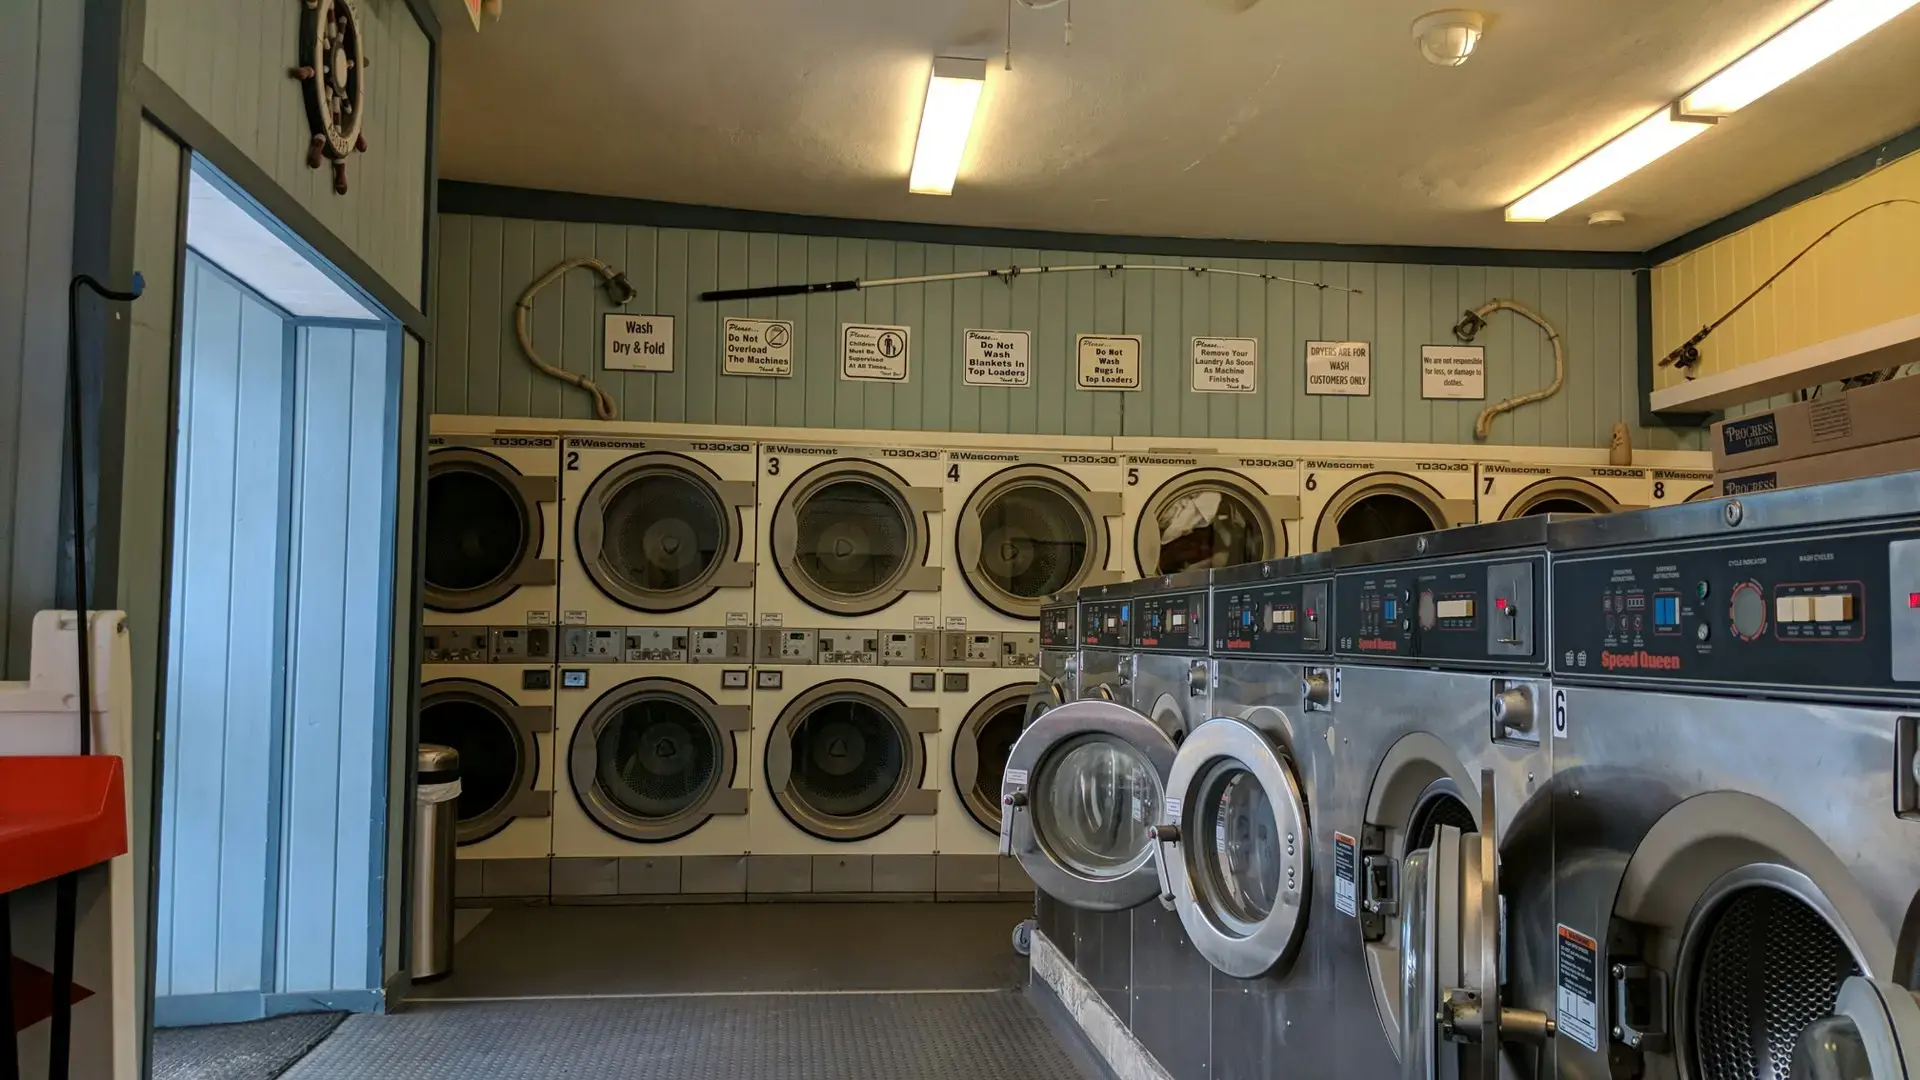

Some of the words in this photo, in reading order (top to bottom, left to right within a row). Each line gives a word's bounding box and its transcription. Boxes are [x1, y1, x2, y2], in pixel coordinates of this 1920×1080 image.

[626, 321, 653, 334] Wash
[728, 334, 740, 342] Do
[613, 341, 631, 355] Dry
[633, 341, 641, 353] &
[644, 342, 664, 354] Fold
[728, 345, 767, 353] Overload
[980, 341, 993, 349] Do
[997, 342, 1014, 350] Not
[984, 350, 1010, 358] Wash
[1311, 347, 1336, 356] DRYERS
[1338, 348, 1351, 356] ARE
[1353, 348, 1366, 357] FOR
[728, 355, 744, 363] The
[748, 356, 788, 365] Machines
[969, 359, 1012, 367] Blankets
[1195, 358, 1223, 366] Laundry
[1330, 361, 1349, 370] WASH
[968, 368, 985, 376] Top
[1094, 367, 1113, 375] Rugs
[1434, 368, 1446, 376] loss,
[1454, 368, 1475, 376] damage
[1086, 376, 1099, 384] Top
[1310, 375, 1348, 385] CUSTOMERS
[1350, 376, 1366, 385] ONLY
[1724, 422, 1774, 442] PROGRESS
[491, 438, 552, 446] TD30x30
[581, 439, 645, 449] Wascomat
[690, 443, 750, 452] TD30x30
[777, 445, 838, 455] Wascomat
[881, 449, 938, 458] TD30x30
[960, 453, 1020, 461] Wascomat
[567, 452, 579, 470] 2
[1062, 455, 1117, 464] TD30x30
[1138, 456, 1197, 465] Wascomat
[1239, 459, 1294, 468] TD30x30
[768, 457, 780, 475] 3
[1316, 461, 1375, 469] Wascomat
[1416, 463, 1468, 471] TD30x30
[1494, 465, 1551, 474] Wascomat
[947, 464, 960, 482] 4
[1128, 468, 1139, 486] 5
[1591, 468, 1643, 477] TD30x30
[1305, 473, 1317, 491] 6
[1484, 477, 1495, 495] 7
[1653, 482, 1664, 499] 8
[1725, 479, 1775, 495] PROGRESS
[1601, 650, 1638, 671] Speed
[1640, 651, 1680, 669] Queen
[1336, 668, 1340, 697] 5
[1556, 690, 1565, 731] 6
